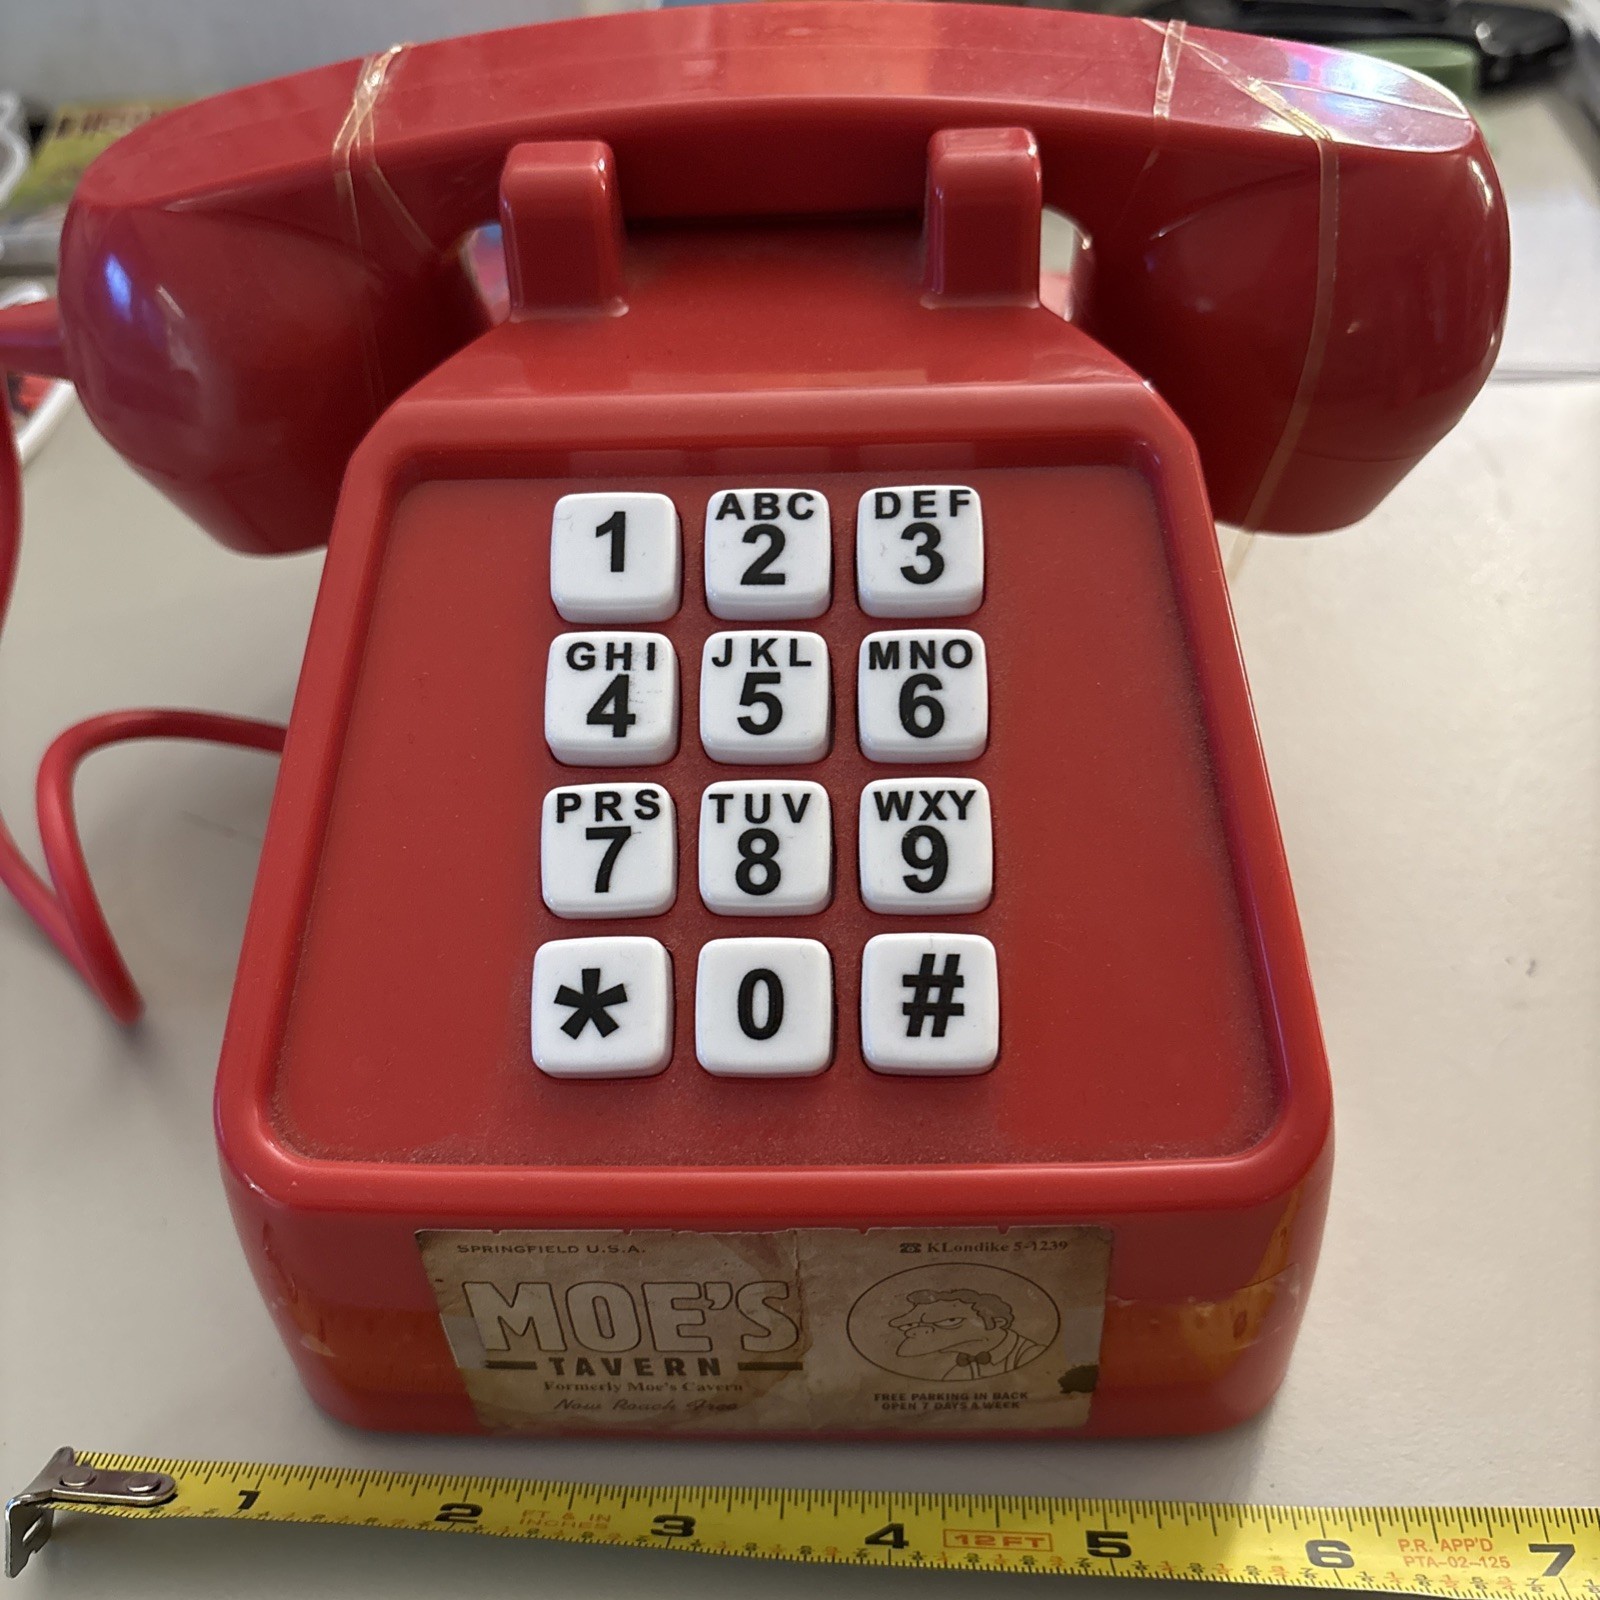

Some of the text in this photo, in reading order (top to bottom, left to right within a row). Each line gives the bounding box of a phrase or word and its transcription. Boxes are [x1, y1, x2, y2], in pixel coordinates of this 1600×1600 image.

[715, 492, 815, 521] ABC
[875, 489, 971, 519] DEF
[594, 511, 627, 573] 1
[739, 523, 786, 585] 2
[900, 522, 945, 584] 3
[566, 641, 656, 671] GHI
[711, 638, 812, 668] JKL
[868, 639, 973, 670] MNO
[586, 674, 636, 738] 4
[737, 672, 783, 736] 5
[899, 673, 945, 738] 6
[556, 789, 661, 823] PRS
[708, 793, 812, 824] TUV
[873, 790, 977, 821] WXY
[585, 826, 632, 893] 7
[735, 828, 782, 895] 8
[901, 825, 949, 893] 9
[737, 968, 785, 1041] 0
[457, 1243, 646, 1255] SPRINGFIELD U.S.A.
[927, 1239, 1068, 1254] KLondike 5-1239
[462, 1280, 799, 1353] MOE'S
[548, 1357, 721, 1377] TAVERN
[543, 1380, 743, 1393] Formerly Moe's Cavern
[874, 1390, 1028, 1402] FREE PARKING IN BACK
[554, 1399, 603, 1411] Now
[881, 1400, 1020, 1411] OPEN 7 DAYS A WEEK
[238, 1490, 261, 1510] 1
[434, 1502, 483, 1524] 2
[650, 1514, 696, 1538] 3
[864, 1522, 910, 1549] 4
[1085, 1530, 1132, 1559] 5
[1304, 1539, 1355, 1569] 6
[1397, 1537, 1494, 1553] P.R. APP'D
[1403, 1554, 1511, 1570] PTA-02-125
[1528, 1543, 1577, 1577] 7
